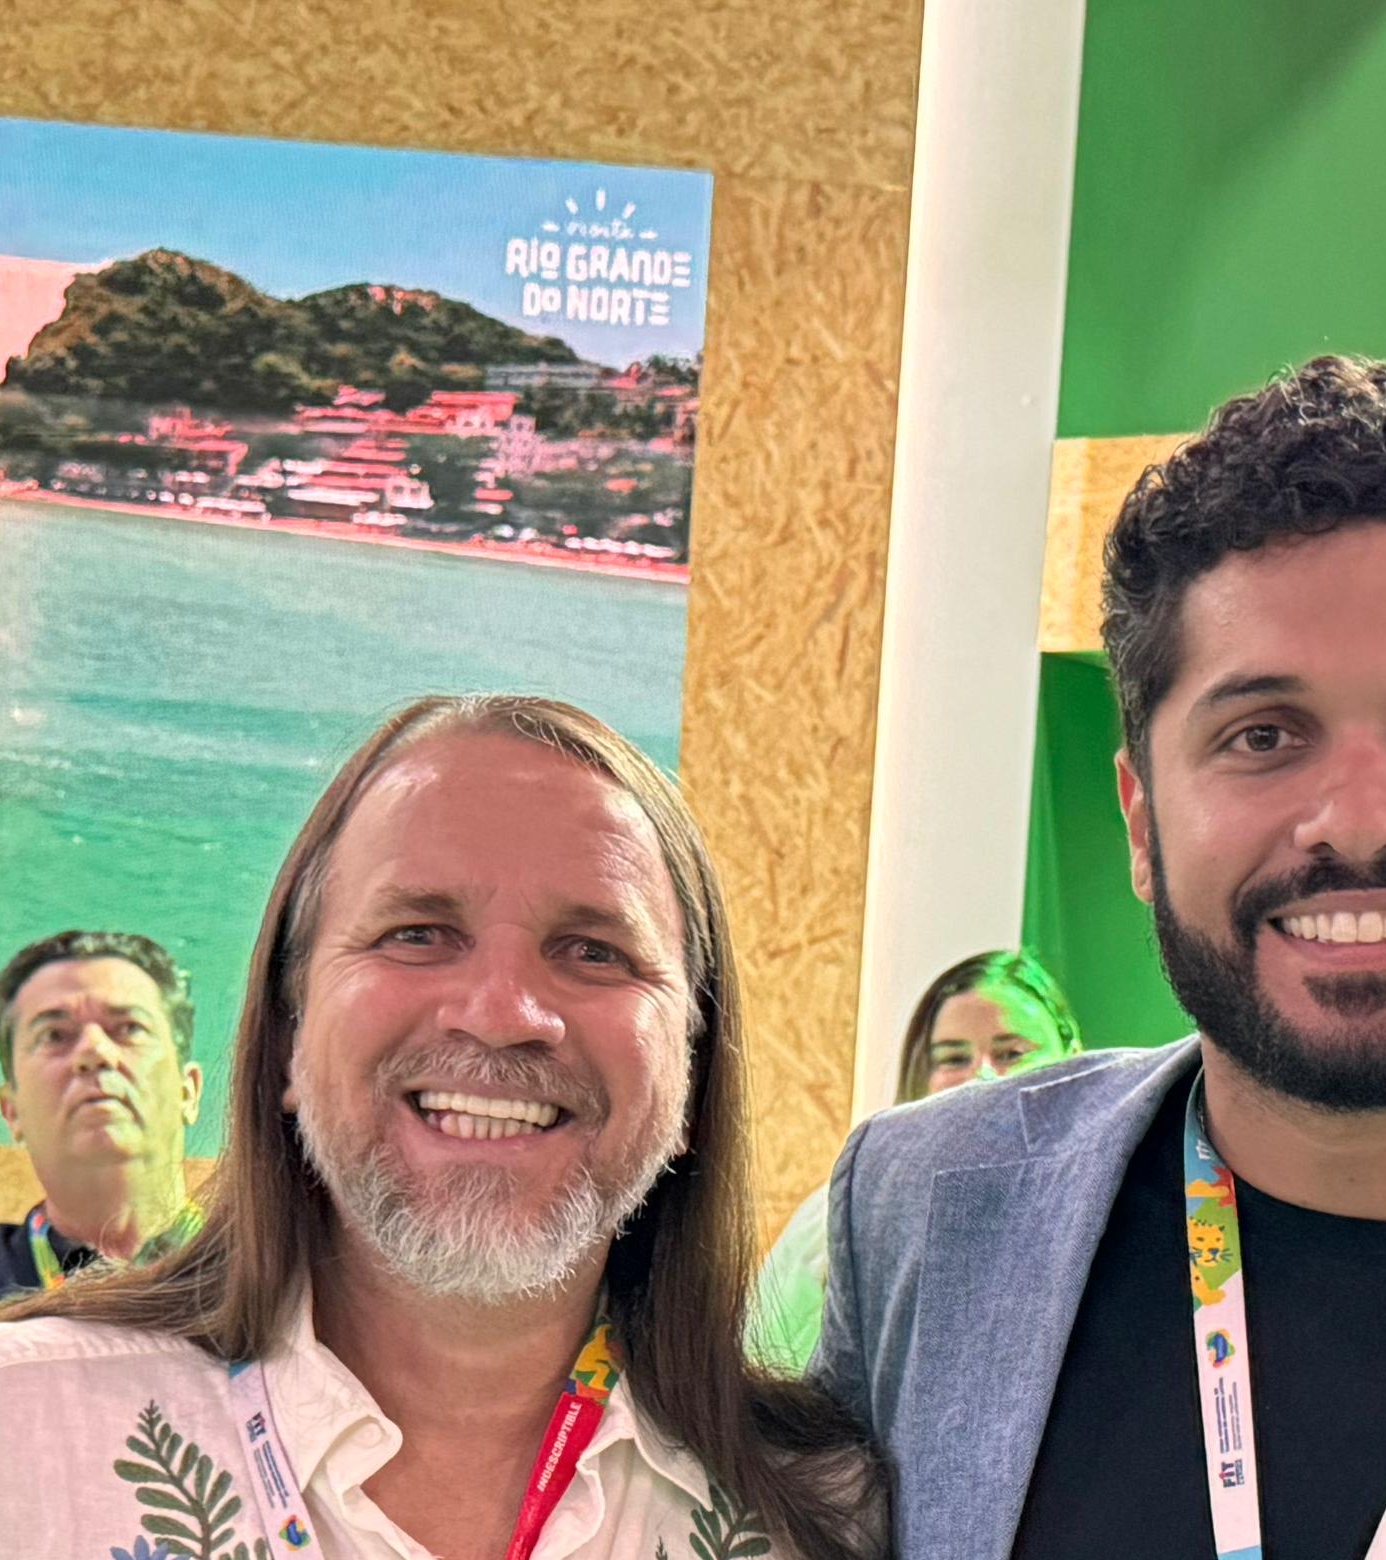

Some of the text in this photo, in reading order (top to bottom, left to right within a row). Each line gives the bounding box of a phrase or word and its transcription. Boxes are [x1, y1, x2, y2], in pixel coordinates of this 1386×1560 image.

[565, 243, 693, 288] GRANDE
[566, 284, 671, 327] NORTE
[536, 1401, 583, 1493] INDESCRIPTIBLE
